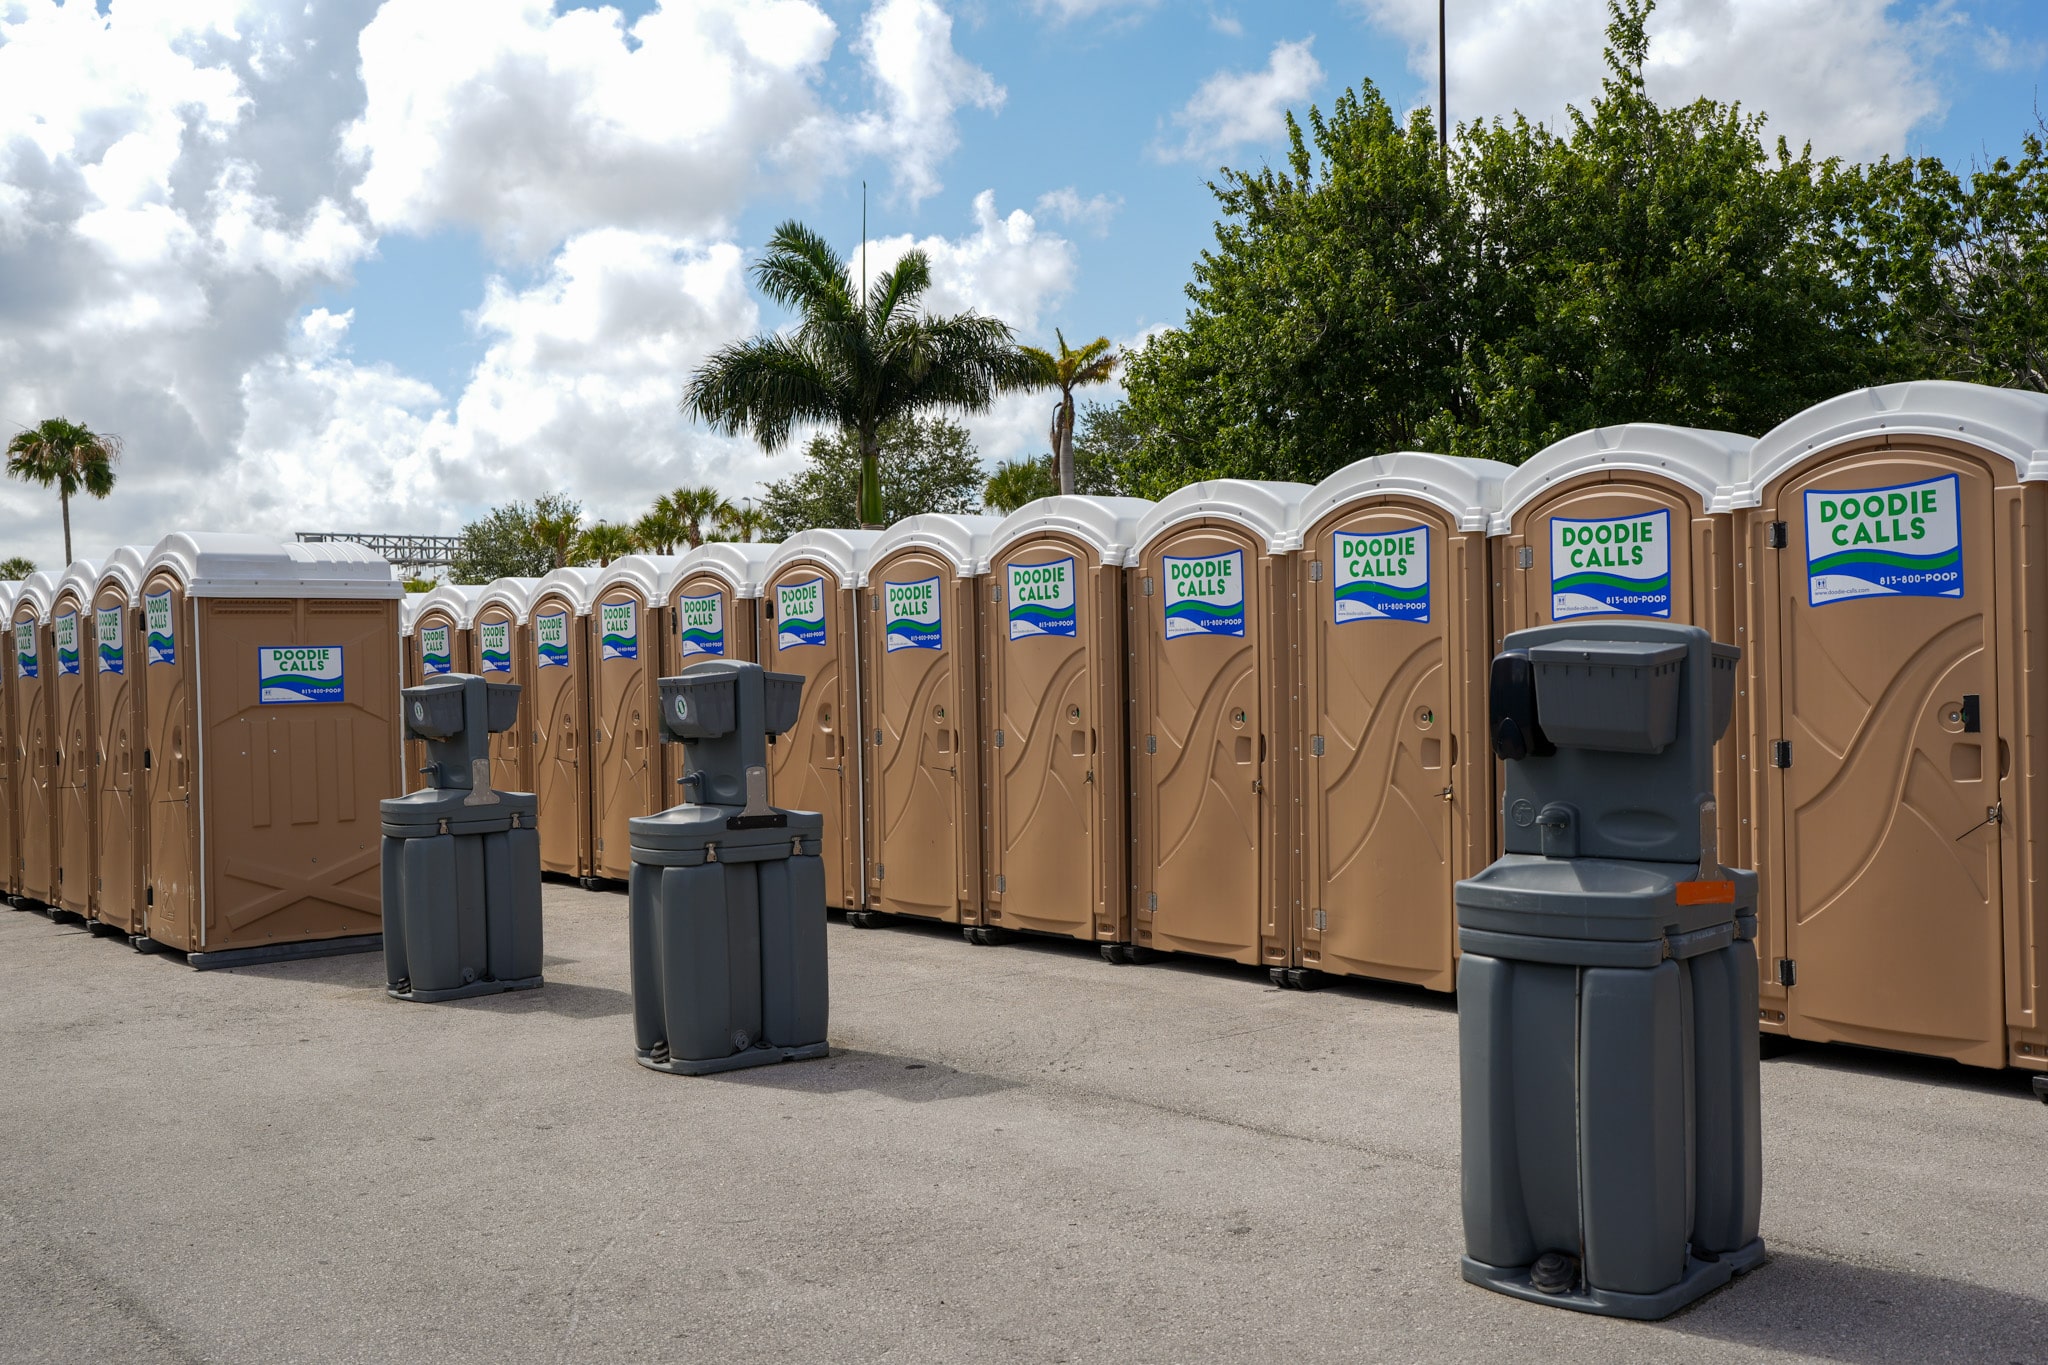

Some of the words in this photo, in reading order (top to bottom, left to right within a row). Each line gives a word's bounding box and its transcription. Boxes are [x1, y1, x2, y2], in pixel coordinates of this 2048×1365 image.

[1820, 489, 1937, 523] DOODIE
[1562, 522, 1652, 547] DOODIE
[1832, 517, 1925, 546] CALLS
[1343, 537, 1415, 558] DOODIE
[1570, 545, 1643, 568] CALLS
[1171, 559, 1231, 580] DOODIE
[1349, 557, 1407, 577] CALLS
[1014, 567, 1065, 586] DOODIE
[1879, 571, 1958, 585] 813-800-POOP
[781, 585, 817, 603] DOODIE
[889, 585, 932, 602] DOODIE
[1018, 584, 1059, 602] CALLS
[1177, 578, 1225, 597] CALLS
[603, 607, 631, 620] DOODIE
[684, 599, 716, 613] DOODIE
[785, 600, 814, 616] CALLS
[893, 600, 928, 617] CALLS
[150, 614, 167, 629] CALLS
[539, 617, 562, 630] DOODIE
[606, 619, 628, 632] CALLS
[687, 612, 713, 626] CALLS
[423, 630, 445, 641] DOODIE
[482, 626, 505, 637] DOODIE
[541, 629, 560, 641] CALLS
[426, 641, 443, 651] CALLS
[485, 637, 503, 648] CALLS
[273, 649, 329, 661] DOODIE
[279, 660, 324, 671] CALLS
